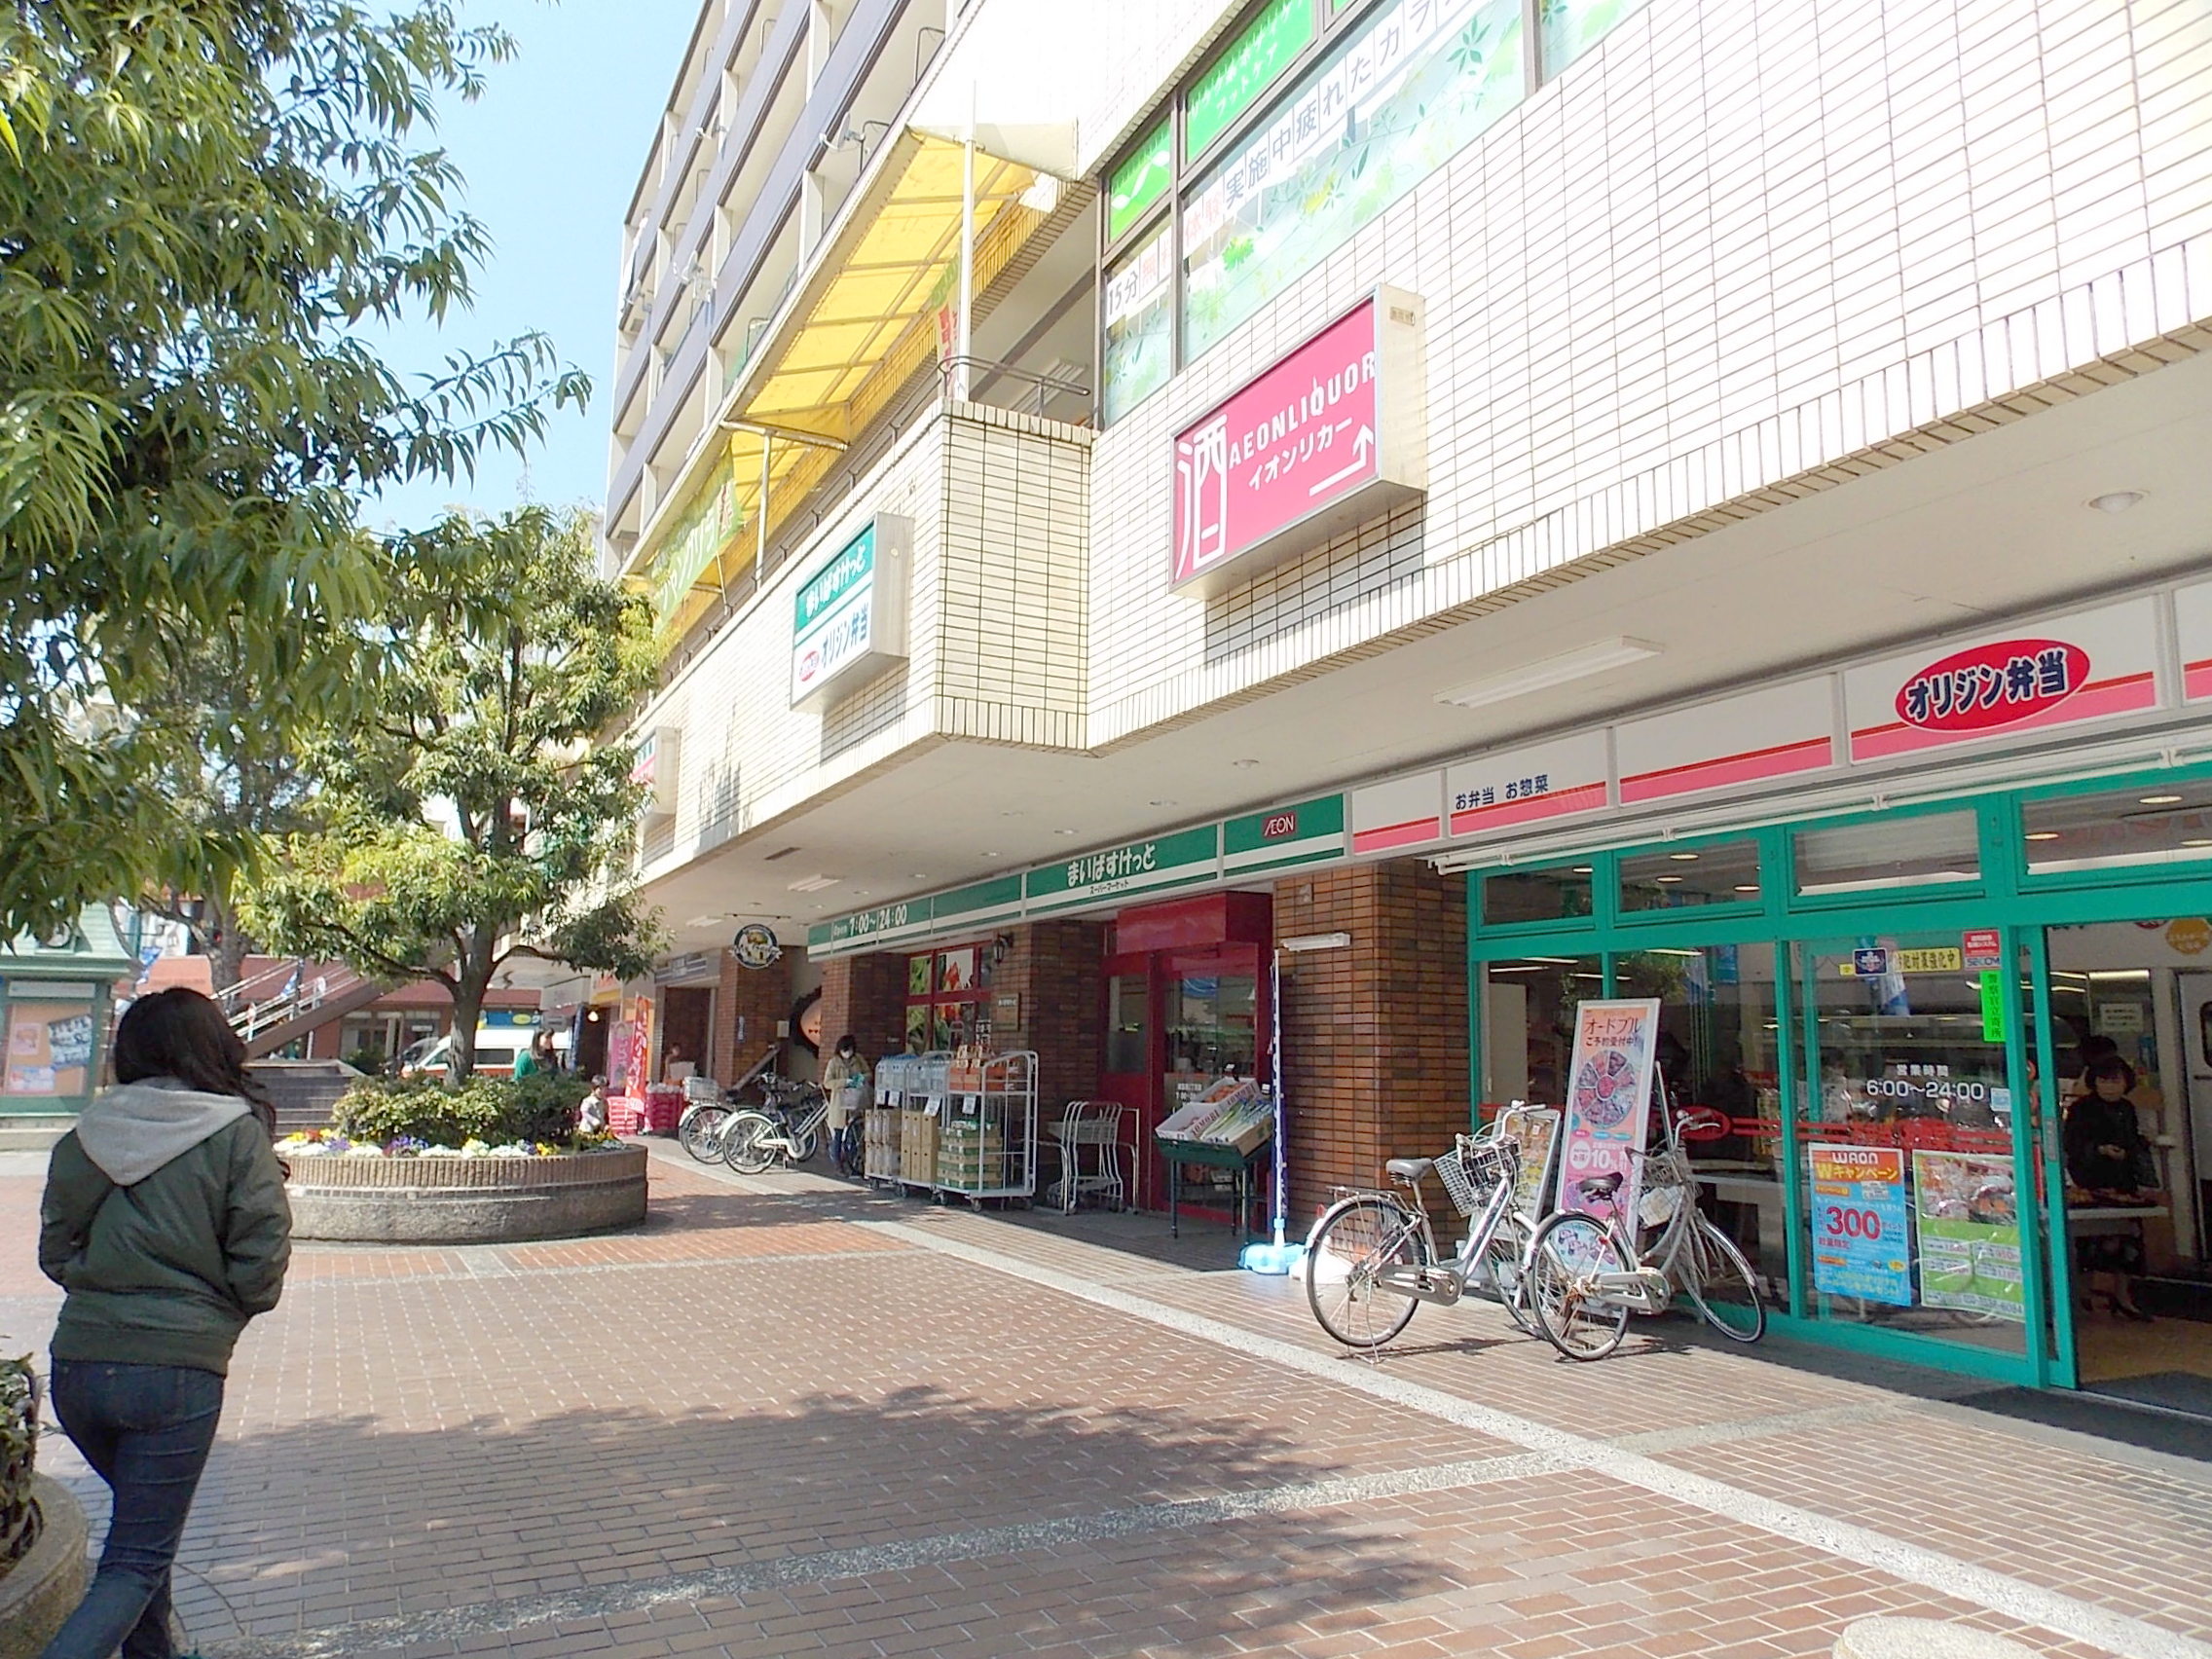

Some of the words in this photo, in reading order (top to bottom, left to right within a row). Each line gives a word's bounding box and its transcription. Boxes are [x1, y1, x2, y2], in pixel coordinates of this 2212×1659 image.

[1249, 418, 1353, 491] イオンリカー
[1175, 414, 1228, 580] 酒
[822, 602, 868, 669] オリジン弁当
[1906, 648, 2066, 720] オリジン弁当
[1456, 787, 1494, 810] お弁当
[1505, 774, 1549, 799] お惣菜
[1067, 843, 1157, 888] まいばすけっと
[1584, 1016, 1641, 1036] オードブル
[1897, 1063, 1949, 1077] 営業時間
[1831, 1152, 1879, 1165] WAON
[1825, 1205, 1881, 1240] 300
